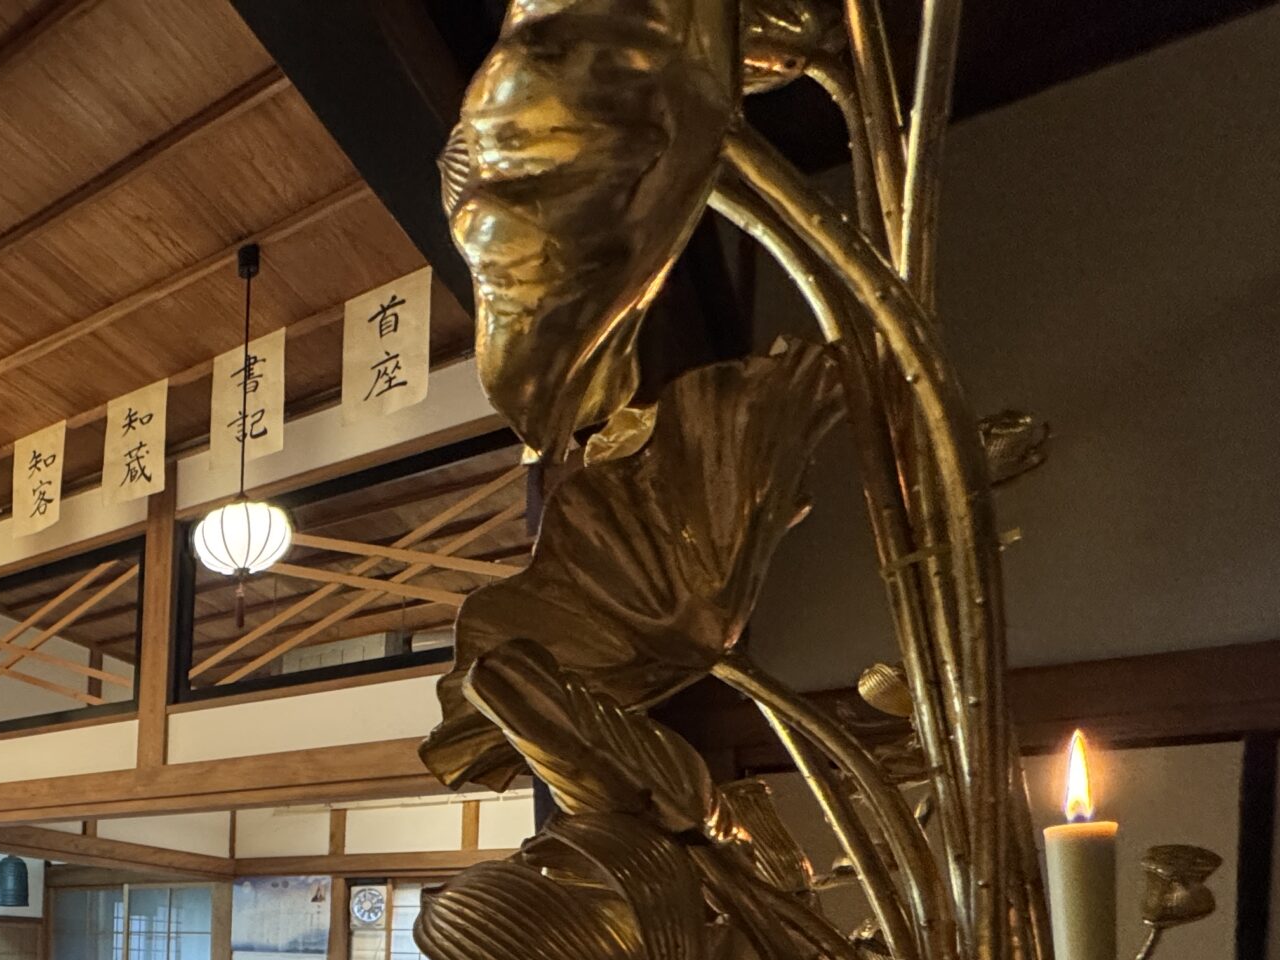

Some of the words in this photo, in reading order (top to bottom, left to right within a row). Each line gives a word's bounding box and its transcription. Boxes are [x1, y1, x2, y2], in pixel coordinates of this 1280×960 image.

[363, 294, 408, 402] 首座
[226, 354, 268, 443] 書記
[28, 450, 56, 518] 知客
[120, 407, 154, 487] 知蔵
